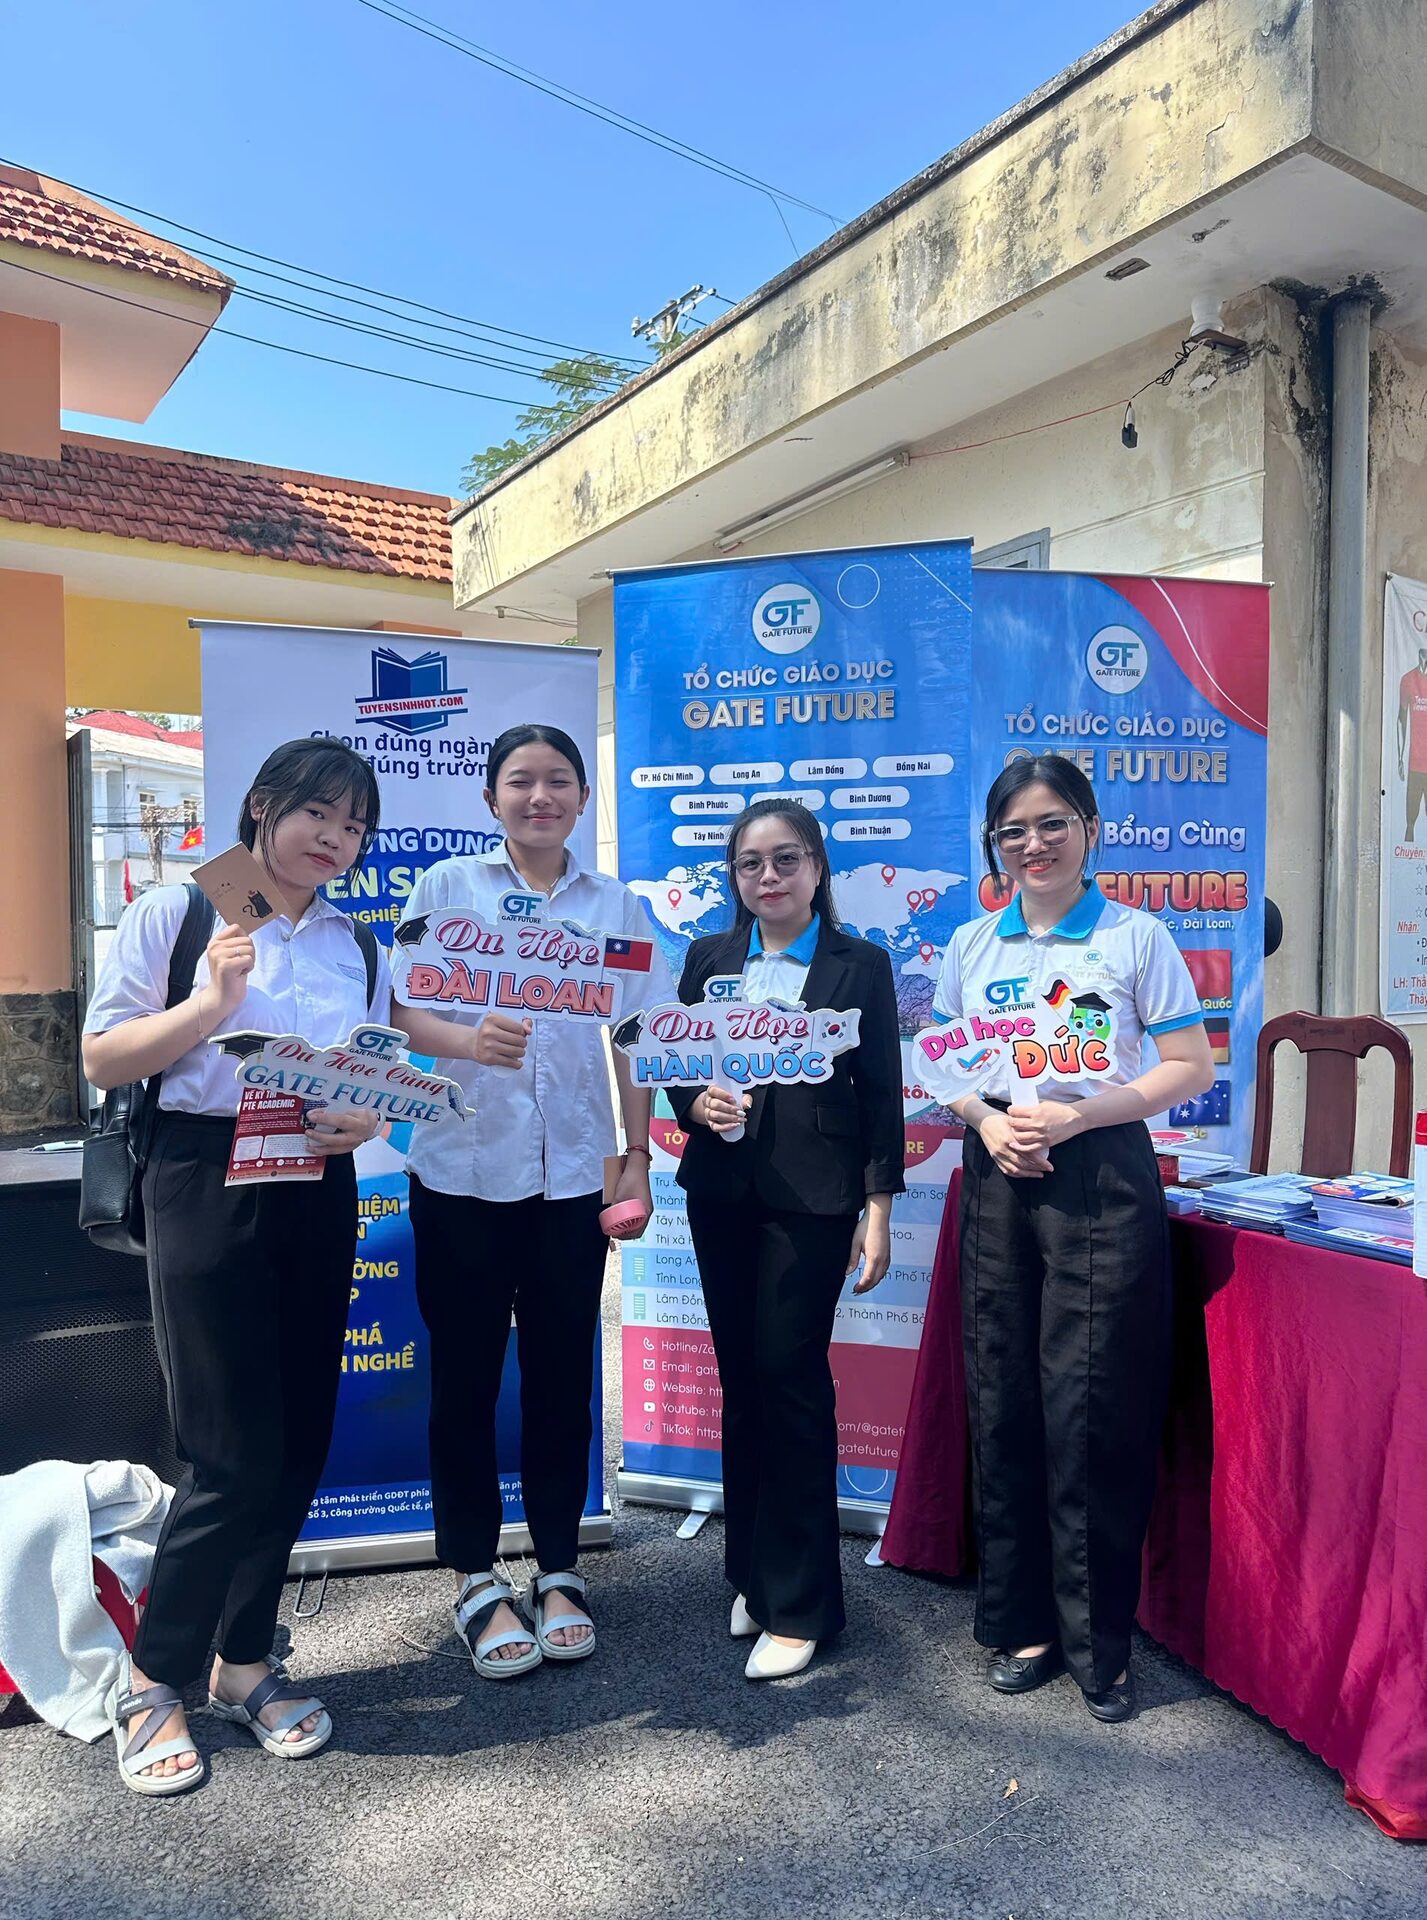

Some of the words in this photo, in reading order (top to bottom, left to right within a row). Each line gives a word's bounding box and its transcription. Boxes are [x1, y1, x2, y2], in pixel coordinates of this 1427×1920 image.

[762, 598, 811, 627] GF
[1413, 610, 1427, 634] C
[762, 628, 781, 638] GATE
[782, 626, 813, 636] FUTURE
[1096, 641, 1140, 666] GF
[683, 663, 710, 691] TỔ
[716, 663, 777, 689] CHỨC
[783, 659, 840, 684] GIÁO
[846, 658, 895, 686] DỤC
[1095, 667, 1113, 677] GATE
[1114, 668, 1141, 677] FUTURE
[358, 695, 465, 716] TUYENSINHHOT.COM
[682, 697, 765, 730] GATE
[775, 689, 896, 726] FUTURE
[1004, 703, 1036, 734] TỔ
[1042, 710, 1109, 736] CHỨC
[1115, 712, 1175, 738] GIÁO
[1181, 717, 1227, 742] DỤC
[375, 733, 431, 757] đúng
[439, 737, 494, 758] ngàn
[808, 765, 822, 776] Lâm
[916, 761, 931, 771] Nai
[1107, 748, 1228, 783] FUTURE
[675, 771, 694, 782] Minh
[732, 769, 748, 780] Long
[750, 769, 761, 779] An
[866, 792, 892, 805] Dương
[707, 831, 725, 841] Ninh
[1104, 814, 1170, 851] Bổng
[1179, 821, 1247, 852] Cùng
[1094, 871, 1248, 913] FUTURE
[503, 894, 543, 915] GF
[501, 915, 518, 923] GATE
[519, 915, 541, 924] FUTURE
[1183, 918, 1203, 929] Đài
[1206, 918, 1235, 930] Loan,
[435, 917, 504, 955] Du
[517, 926, 599, 969] Học
[406, 957, 492, 1009] ĐÀI
[496, 972, 615, 1017] LOAN
[709, 980, 740, 996] GF
[984, 976, 1032, 1008] GF
[988, 1005, 1007, 1015] GATE
[1007, 1002, 1036, 1013] FUTURE
[1202, 996, 1233, 1010] Quốc
[650, 1010, 716, 1043] Du
[726, 1008, 811, 1044] Học
[356, 1031, 403, 1052] GF
[919, 1027, 968, 1062] Du
[969, 1016, 1036, 1044] học
[349, 1047, 367, 1056] GATE
[367, 1051, 393, 1062] FUTURE
[271, 1040, 316, 1063] Du
[325, 1051, 377, 1078] Học
[385, 1066, 447, 1096] Cùng
[637, 1049, 714, 1082] HÀN
[722, 1042, 826, 1084] QUỐC
[244, 1065, 329, 1097] GATE
[331, 1082, 445, 1123] FUTURE
[242, 1101, 256, 1111] PTE
[257, 1099, 296, 1110] ACADEMIC
[655, 1177, 670, 1190] Trụ
[655, 1195, 687, 1206] Thành
[906, 1188, 927, 1200] Tân
[656, 1215, 673, 1227] Tây
[656, 1234, 670, 1246] Thị
[672, 1235, 685, 1245] xã
[656, 1254, 682, 1268] Long
[895, 1270, 918, 1282] Phố
[656, 1293, 679, 1304] Lâm
[656, 1312, 679, 1324] Lâm
[849, 1308, 883, 1320] Thành
[887, 1311, 909, 1323] Phố
[353, 1341, 416, 1373] NGHỀ
[661, 1361, 693, 1373] Email:
[696, 1364, 720, 1376] gate
[662, 1382, 706, 1395] Website:
[662, 1402, 709, 1416] Youtube:
[662, 1422, 694, 1436] TikTok:
[838, 1444, 899, 1458] gatefuture
[339, 1493, 360, 1504] Phát
[410, 1488, 430, 1499] phía
[330, 1508, 353, 1518] Công
[354, 1505, 386, 1517] trường
[387, 1501, 411, 1513] Quốc
